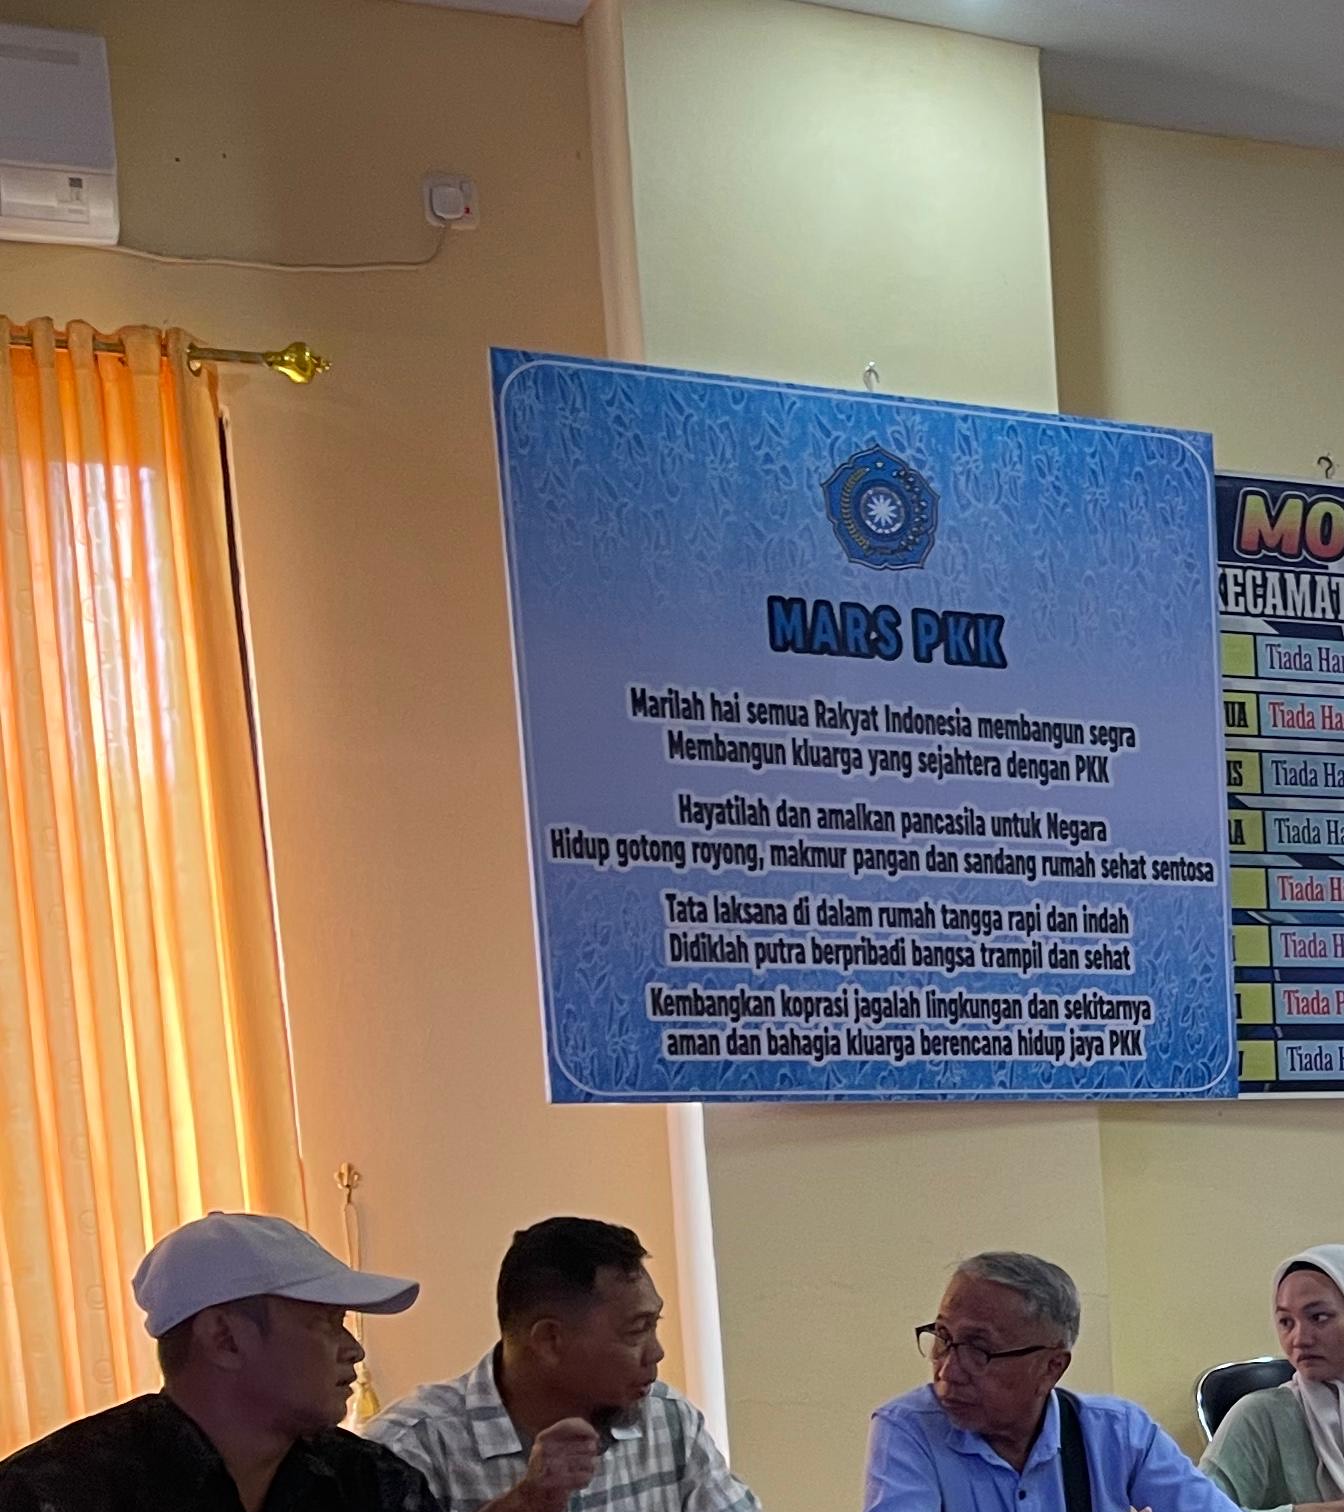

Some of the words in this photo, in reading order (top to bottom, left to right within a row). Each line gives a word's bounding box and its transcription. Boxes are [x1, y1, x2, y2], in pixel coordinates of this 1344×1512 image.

[767, 595, 903, 661] MARS
[911, 607, 1008, 669] PKK
[1266, 644, 1312, 671] Tiada
[630, 687, 705, 721] Marilah
[710, 691, 741, 723] hai
[746, 701, 809, 727] semua
[814, 699, 879, 736] Rakyat
[884, 704, 972, 738] Indonesia
[977, 713, 1085, 749] membangun
[1089, 725, 1136, 753] segra
[1269, 702, 1315, 730] Tiada
[667, 729, 787, 771] Membangun
[791, 737, 863, 775] kluarga
[867, 748, 913, 779] yang
[918, 744, 1002, 780] sejahtera
[1006, 750, 1070, 786] dengan
[1075, 754, 1110, 783] PKK
[1271, 760, 1318, 788] Tiada
[678, 793, 771, 831] Hayatilah
[776, 798, 811, 829] dan
[817, 802, 896, 832] amalkan
[900, 806, 986, 839] pancasila
[991, 811, 1042, 839] untuk
[1046, 811, 1107, 847] Negara
[1274, 818, 1320, 845] Tiada
[550, 827, 610, 867] Hidup
[616, 834, 686, 869] gotong
[691, 841, 764, 872] royong,
[769, 838, 847, 869] makmur
[853, 848, 920, 877] pangan
[925, 844, 959, 873] dan
[964, 847, 1037, 882] sandang
[1041, 850, 1096, 878] rumah
[1101, 852, 1147, 880] sehat
[1151, 856, 1214, 882] sentosa
[1277, 875, 1324, 902] Tiada
[665, 893, 708, 923] Tata
[713, 894, 788, 925] laksana
[793, 895, 811, 926] di
[816, 898, 873, 927] dalam
[878, 901, 936, 929] rumah
[941, 904, 1003, 937] tangga
[1007, 903, 1042, 938] rapi
[1046, 905, 1078, 933] dan
[1082, 904, 1129, 934] indah
[669, 931, 749, 963] Didiklah
[754, 937, 806, 970] putra
[811, 935, 906, 972] berpribadi
[911, 938, 975, 973] bangsa
[980, 940, 1043, 975] trampil
[1048, 942, 1080, 970] dan
[1084, 943, 1131, 971] sehat
[1281, 932, 1328, 958] Tiada
[650, 984, 776, 1024] Kembangkan
[780, 988, 849, 1024] koprasi
[854, 988, 921, 1029] jagalah
[925, 989, 1023, 1027] lingkungan
[1027, 992, 1059, 1020] dan
[1064, 991, 1151, 1026] sekitarnya
[1283, 989, 1330, 1015] Tiada
[667, 1033, 721, 1056] aman
[726, 1025, 762, 1056] dan
[766, 1026, 841, 1064] bahagia
[846, 1025, 915, 1062] kluarga
[919, 1025, 1013, 1056] berencana
[1017, 1027, 1065, 1062] hidup
[1069, 1025, 1105, 1064] jaya
[1109, 1029, 1143, 1056] PKK
[1286, 1046, 1333, 1072] Tiada
